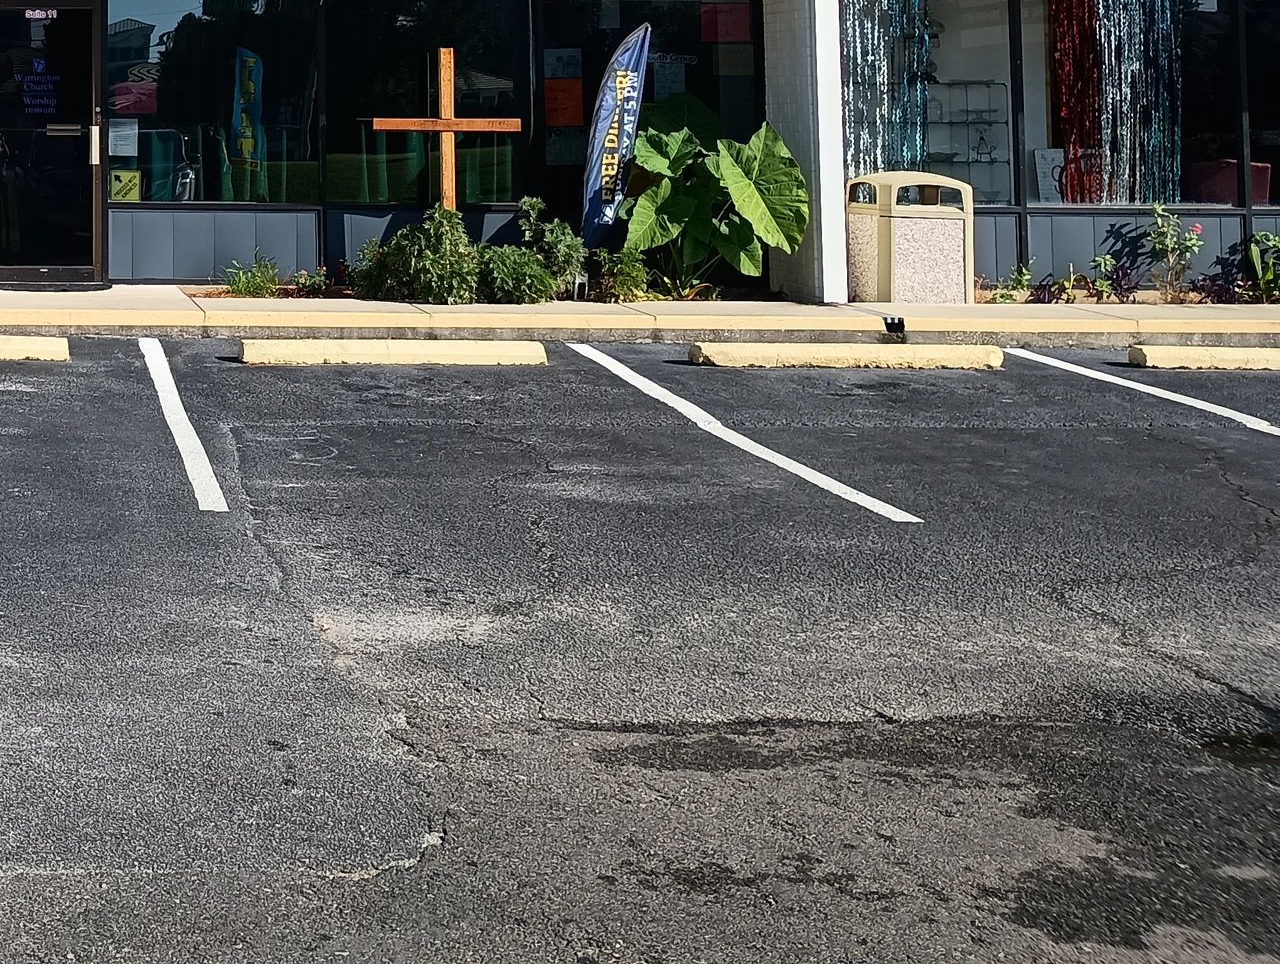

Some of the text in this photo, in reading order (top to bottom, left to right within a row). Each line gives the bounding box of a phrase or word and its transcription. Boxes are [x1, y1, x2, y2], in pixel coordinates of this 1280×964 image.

[25, 9, 57, 18] Suite 11
[14, 73, 60, 84] Warrington
[23, 82, 54, 91] Church
[623, 71, 638, 98] PM
[22, 96, 57, 106] Worship
[623, 100, 637, 110] 5
[623, 112, 635, 135] AT
[601, 153, 619, 201] FREE
